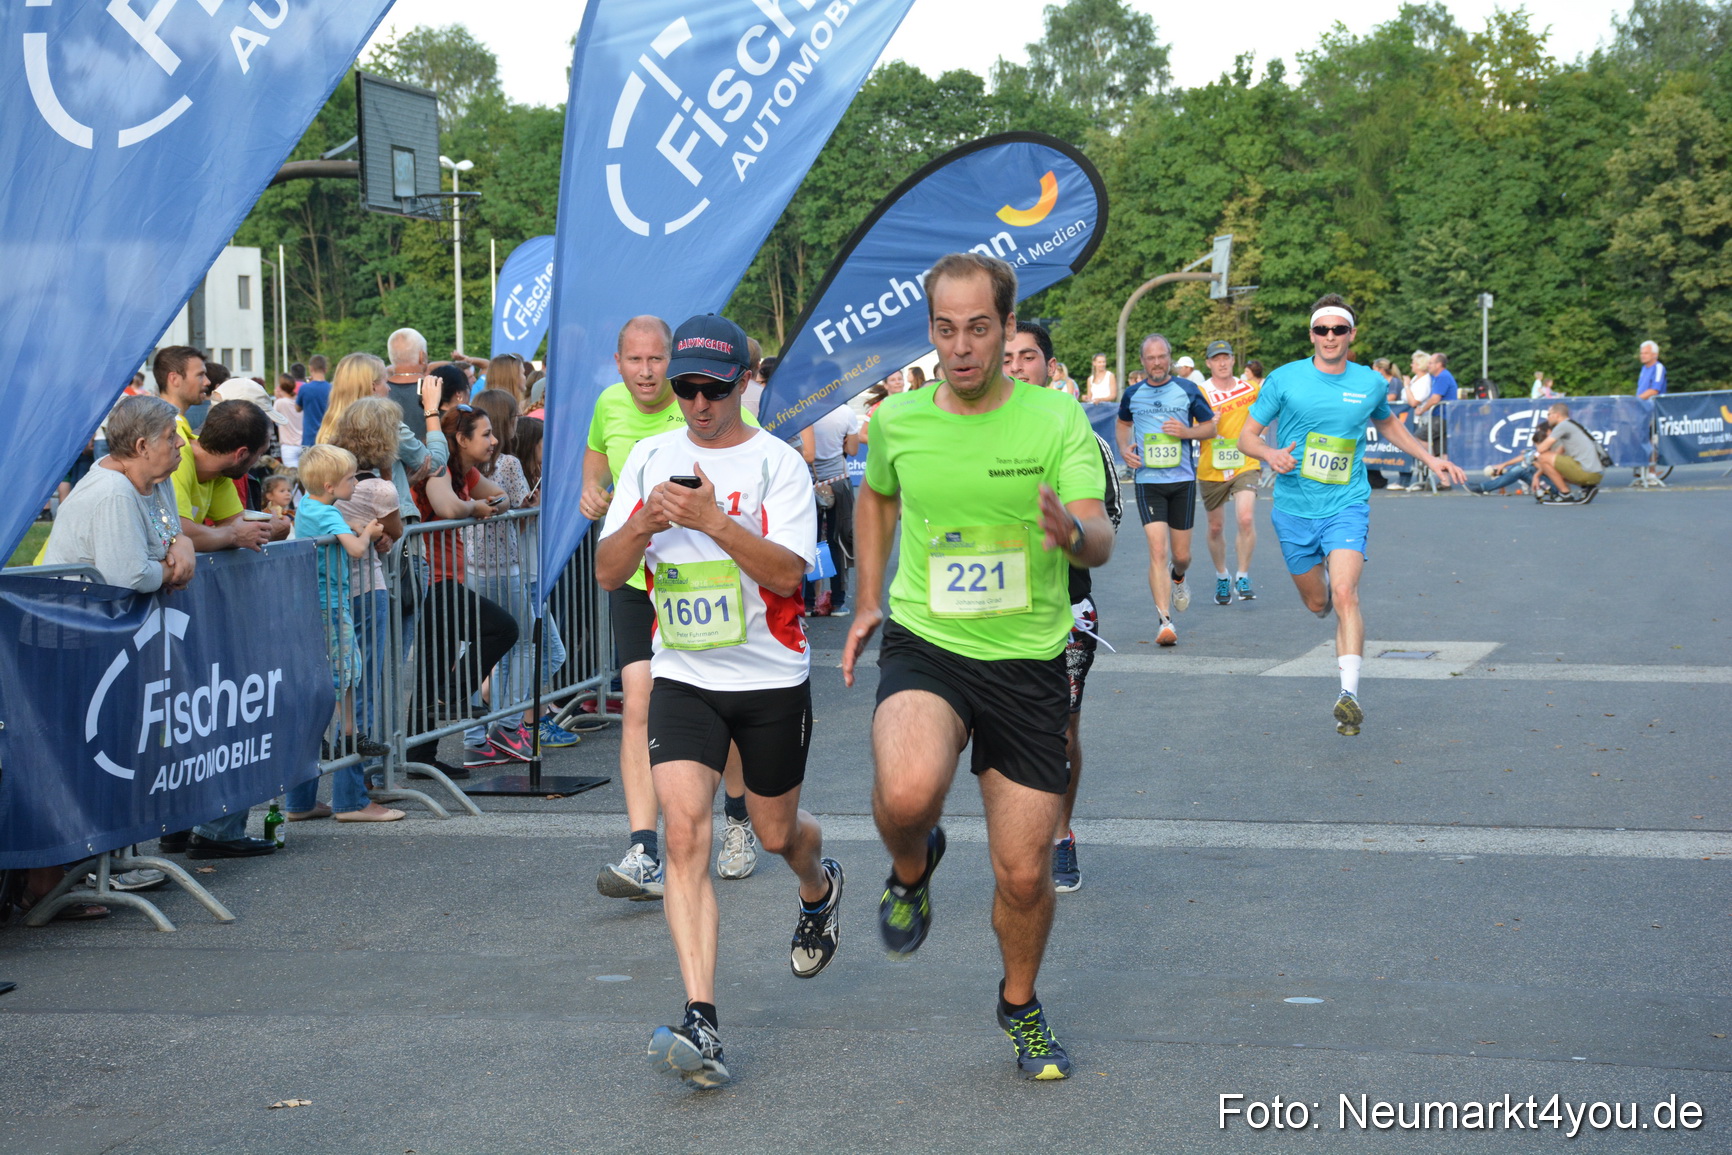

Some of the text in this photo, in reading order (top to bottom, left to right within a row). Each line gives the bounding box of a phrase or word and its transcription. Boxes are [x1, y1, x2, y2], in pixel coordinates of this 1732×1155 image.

[1027, 219, 1087, 261] Medien
[705, 338, 732, 355] GREEN
[1657, 414, 1725, 436] Frischmann
[1148, 446, 1178, 458] 1333
[1218, 450, 1240, 461] 856
[1309, 451, 1349, 472] 1063
[988, 465, 1045, 478] SMART POWER
[946, 560, 1005, 592] 221
[662, 594, 730, 626] 1601
[137, 662, 283, 754] Fischer
[149, 733, 273, 795] AUTOMOBILE
